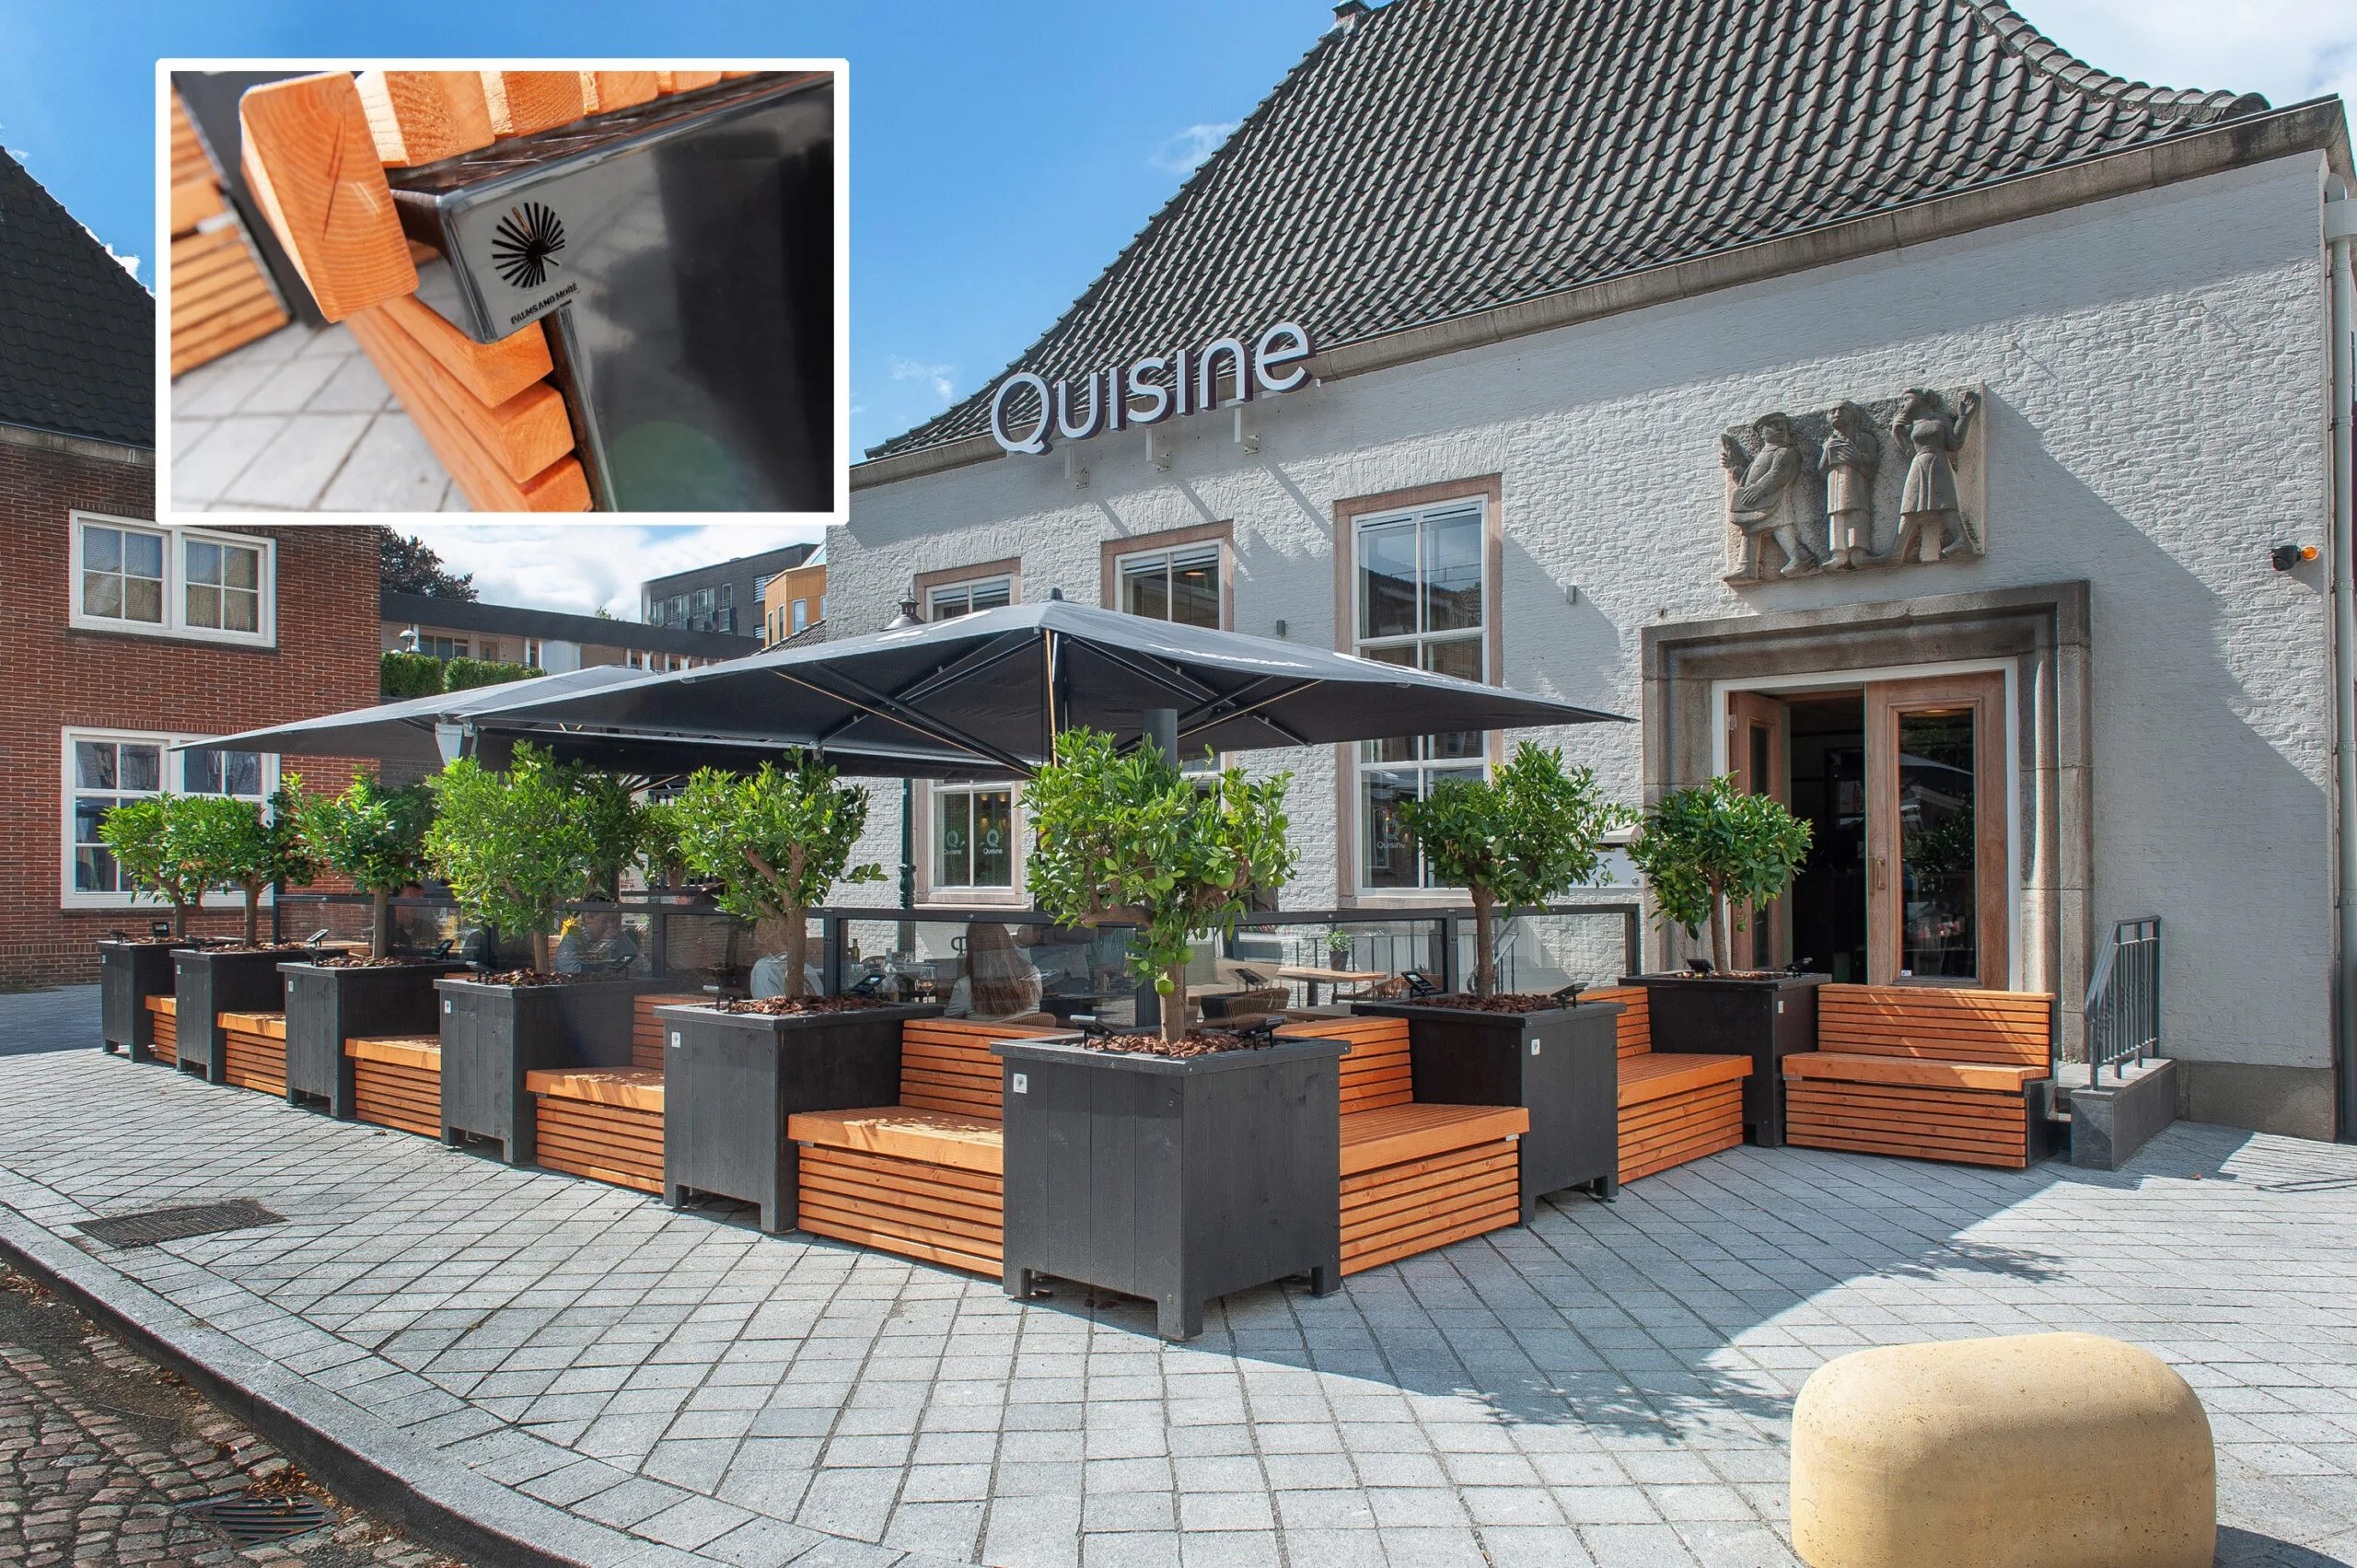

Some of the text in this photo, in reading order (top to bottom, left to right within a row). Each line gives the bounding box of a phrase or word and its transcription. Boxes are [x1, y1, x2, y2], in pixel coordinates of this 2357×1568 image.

[991, 321, 1317, 455] Quisine
[946, 830, 959, 849] Q
[986, 829, 1000, 847] Q
